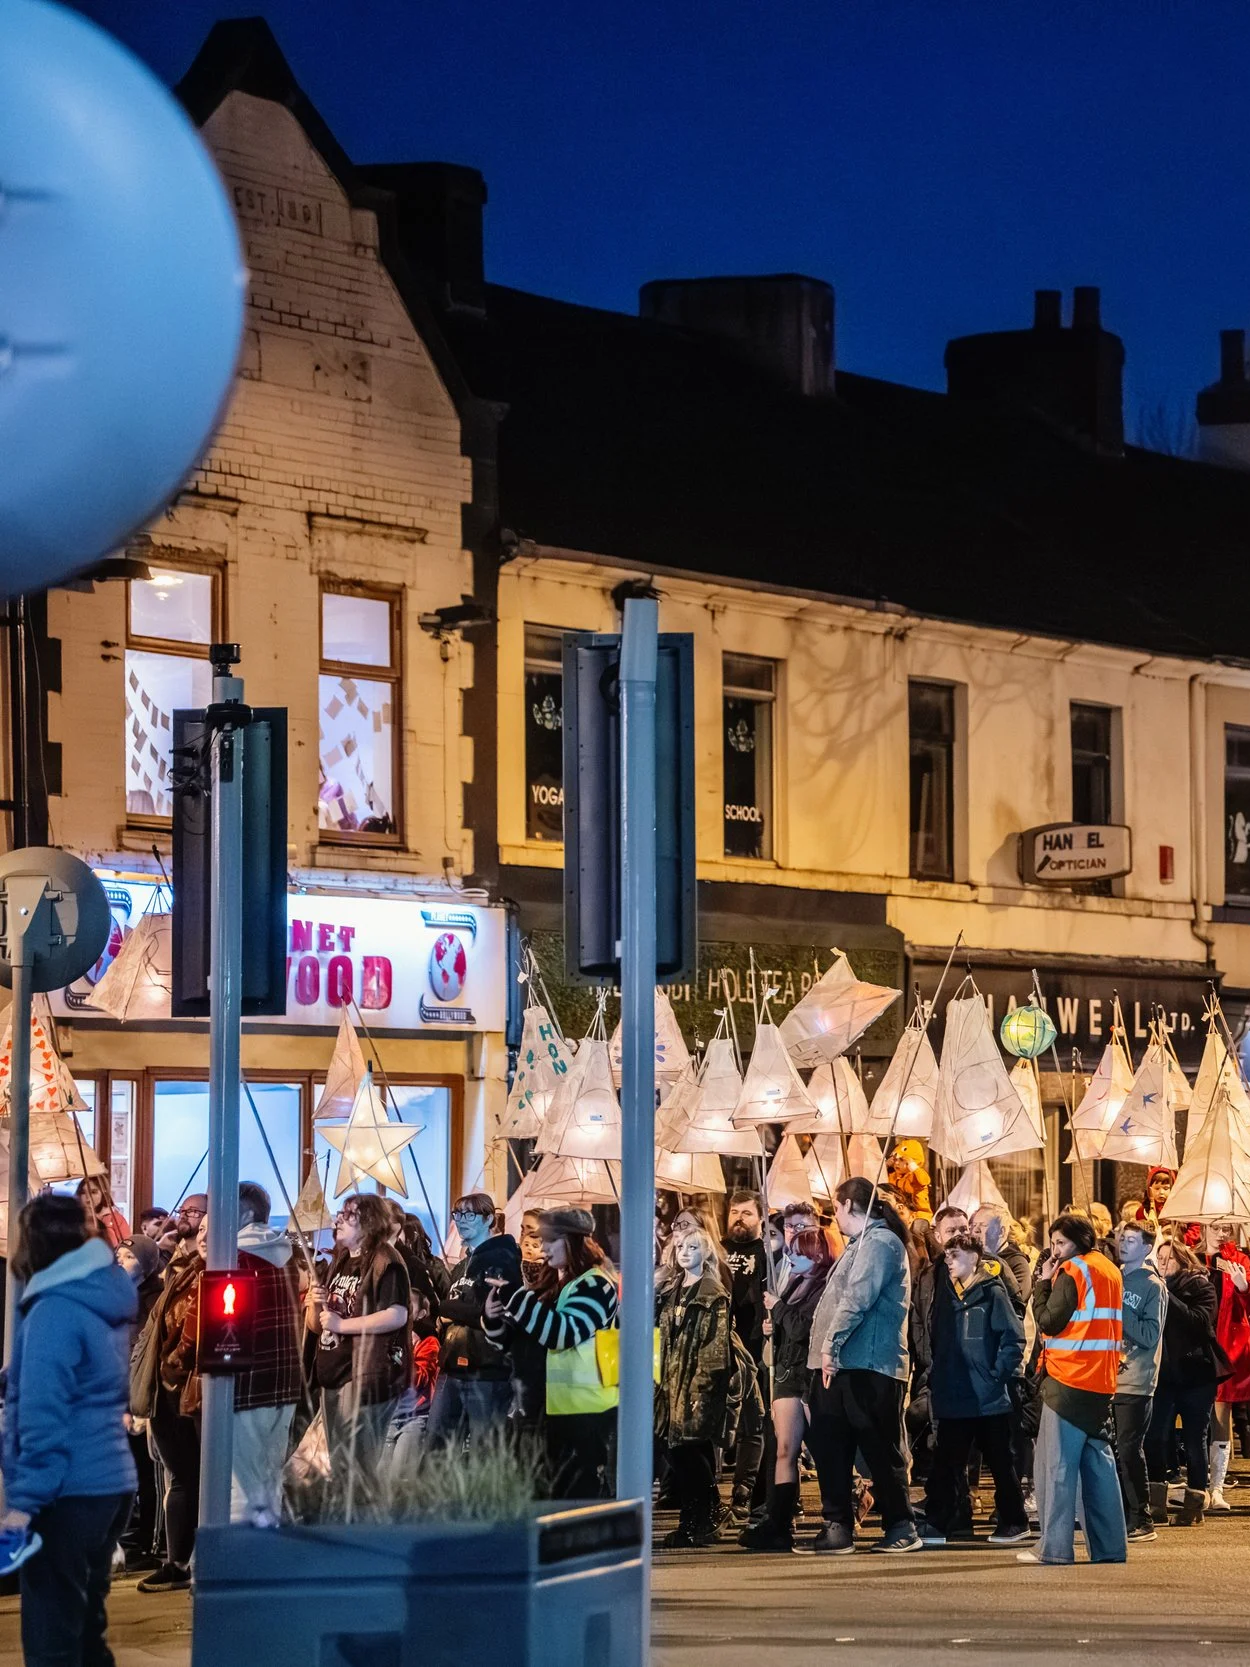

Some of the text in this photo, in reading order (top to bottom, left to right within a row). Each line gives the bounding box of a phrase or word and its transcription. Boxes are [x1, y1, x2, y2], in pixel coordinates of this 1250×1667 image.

[531, 785, 564, 806] YOGA
[725, 804, 762, 822] SCHOOL
[1049, 858, 1106, 871] OPTICIAN
[291, 918, 355, 952] NET
[286, 955, 392, 1010] OOD
[760, 970, 797, 1005] TEA
